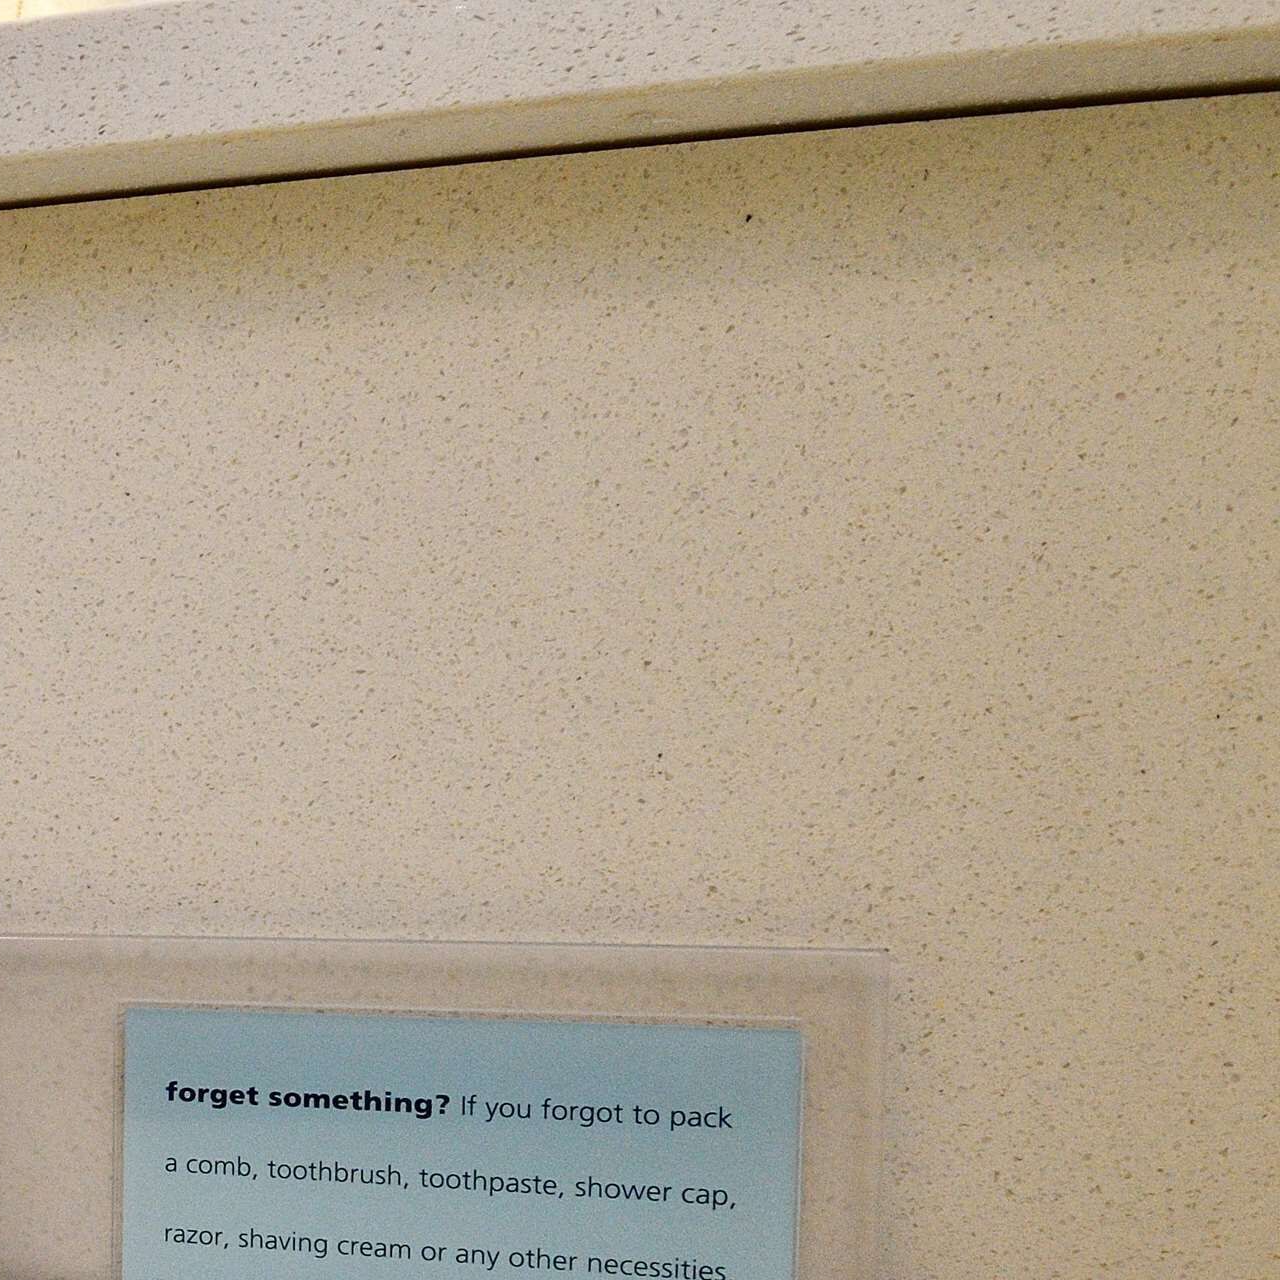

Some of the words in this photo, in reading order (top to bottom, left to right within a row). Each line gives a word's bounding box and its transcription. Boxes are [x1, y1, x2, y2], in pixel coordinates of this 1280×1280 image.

[165, 1081, 259, 1109] forget
[268, 1090, 450, 1119] something?
[461, 1095, 478, 1116] If
[485, 1100, 532, 1122] you
[541, 1098, 624, 1128] forgot
[633, 1104, 660, 1126] to
[670, 1106, 733, 1132] pack
[164, 1156, 177, 1173] a
[186, 1156, 258, 1180] comb,
[267, 1160, 409, 1190] toothbrush,
[419, 1168, 564, 1199] toothpaste,
[575, 1176, 672, 1202] shower
[681, 1186, 737, 1210] cap,
[164, 1227, 229, 1249] razor,
[239, 1228, 328, 1259] shaving
[337, 1238, 411, 1260] cream
[421, 1244, 447, 1262] or
[455, 1247, 500, 1271] any
[508, 1248, 578, 1272] other
